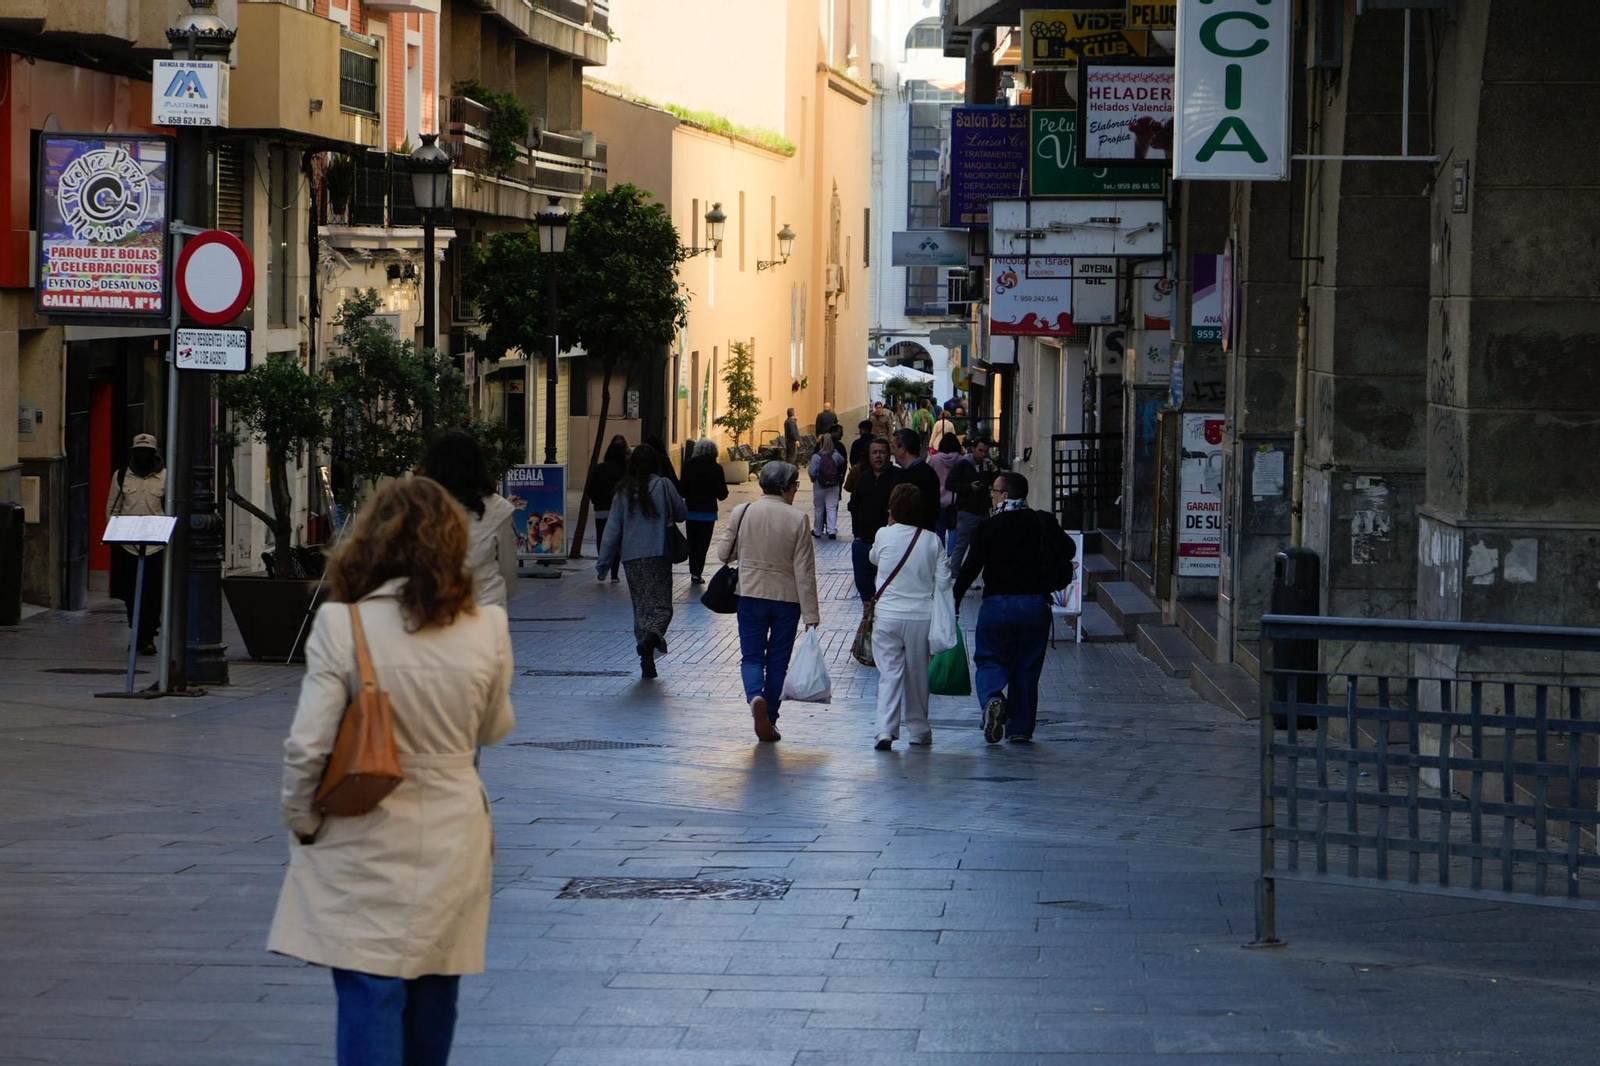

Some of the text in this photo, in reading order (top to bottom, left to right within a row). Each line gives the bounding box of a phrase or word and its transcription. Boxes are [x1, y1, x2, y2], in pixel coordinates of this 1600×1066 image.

[1083, 41, 1128, 57] CLUB
[1195, 0, 1272, 163] CIA
[1090, 102, 1129, 112] Helados
[168, 116, 211, 125] 659 624 735
[956, 112, 987, 128] Salón
[992, 113, 1006, 128] De
[963, 132, 1001, 147] Luisa
[1099, 133, 1131, 146] Propia
[965, 151, 1022, 159] TRATAMIENTOS
[62, 148, 146, 188] Coffee Park
[964, 162, 1017, 170] MAQUILLAJES
[1117, 182, 1130, 190] 959
[68, 209, 136, 241] Marina
[51, 247, 157, 260] PARQUE DE BOLAS
[50, 261, 157, 275] Y CELEBRACIONES
[1079, 264, 1113, 273] JOYERIA
[48, 278, 158, 290] EVENTOS DESAYUNOS
[43, 294, 80, 308] CALLE
[81, 295, 133, 309] MARINA,
[178, 331, 196, 346] EXCEPTO
[197, 332, 222, 347] RESIDENTES
[227, 334, 246, 349] GARAJES
[1197, 330, 1214, 339] 959
[210, 351, 227, 365] AGOSTO
[507, 468, 544, 481] REGALA
[1186, 515, 1222, 530] DE SU
